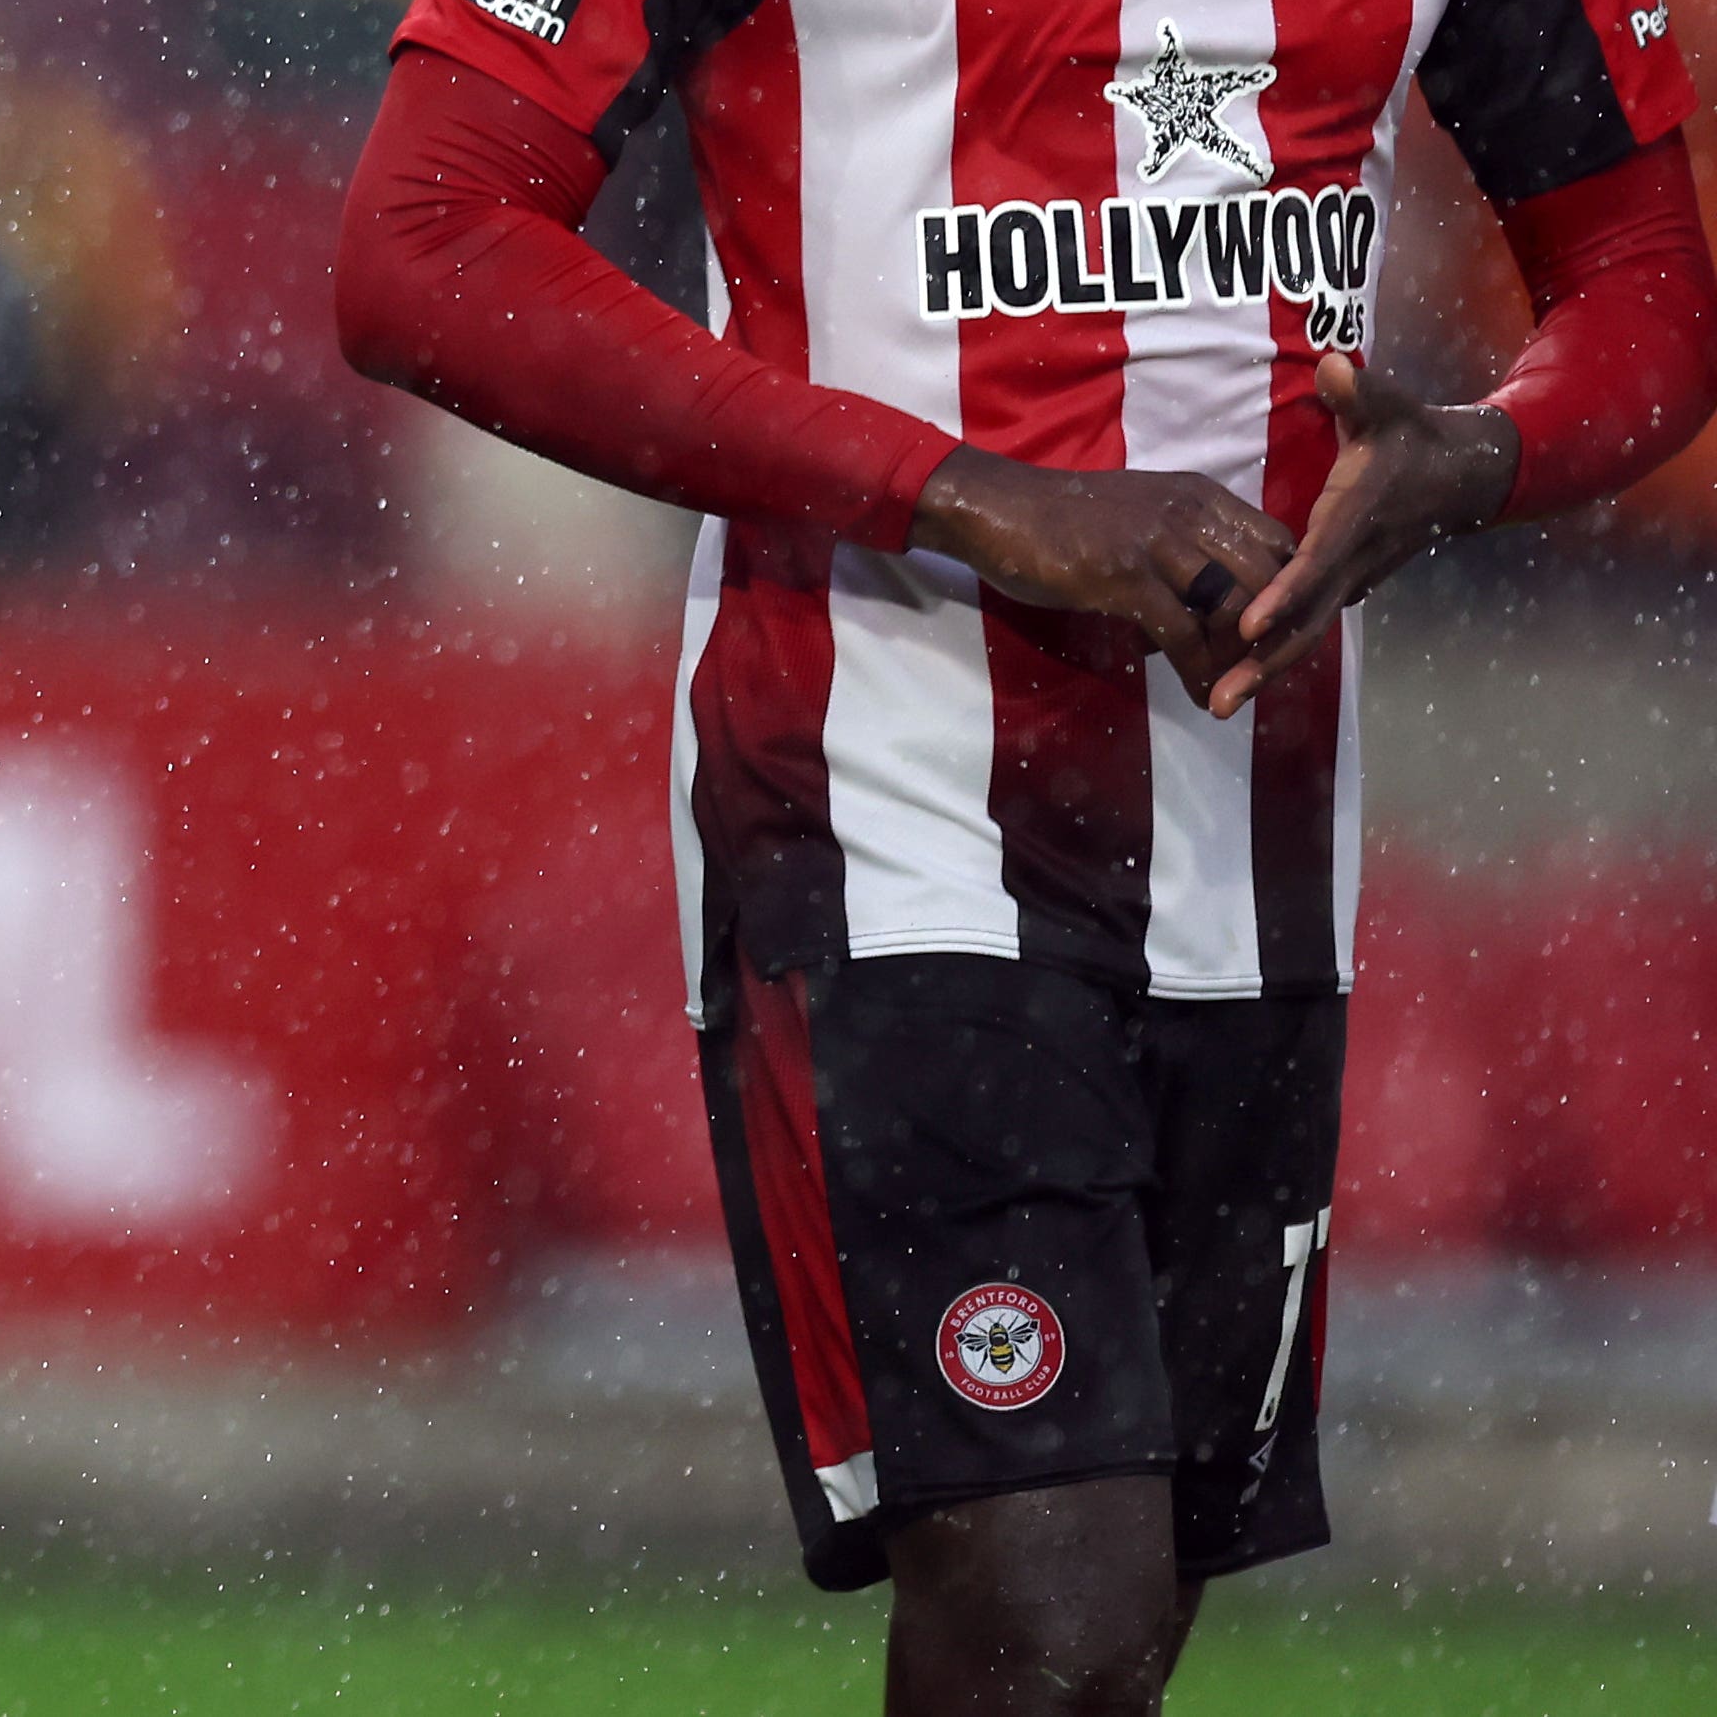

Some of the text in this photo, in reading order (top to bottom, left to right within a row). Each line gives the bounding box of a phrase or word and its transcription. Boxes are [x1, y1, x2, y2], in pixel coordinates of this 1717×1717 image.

[921, 190, 1377, 315] HOLLYWOOD
[949, 1291, 1038, 1328] BRENTFORD
[961, 1365, 1051, 1400] FOOTBALL CLUB
